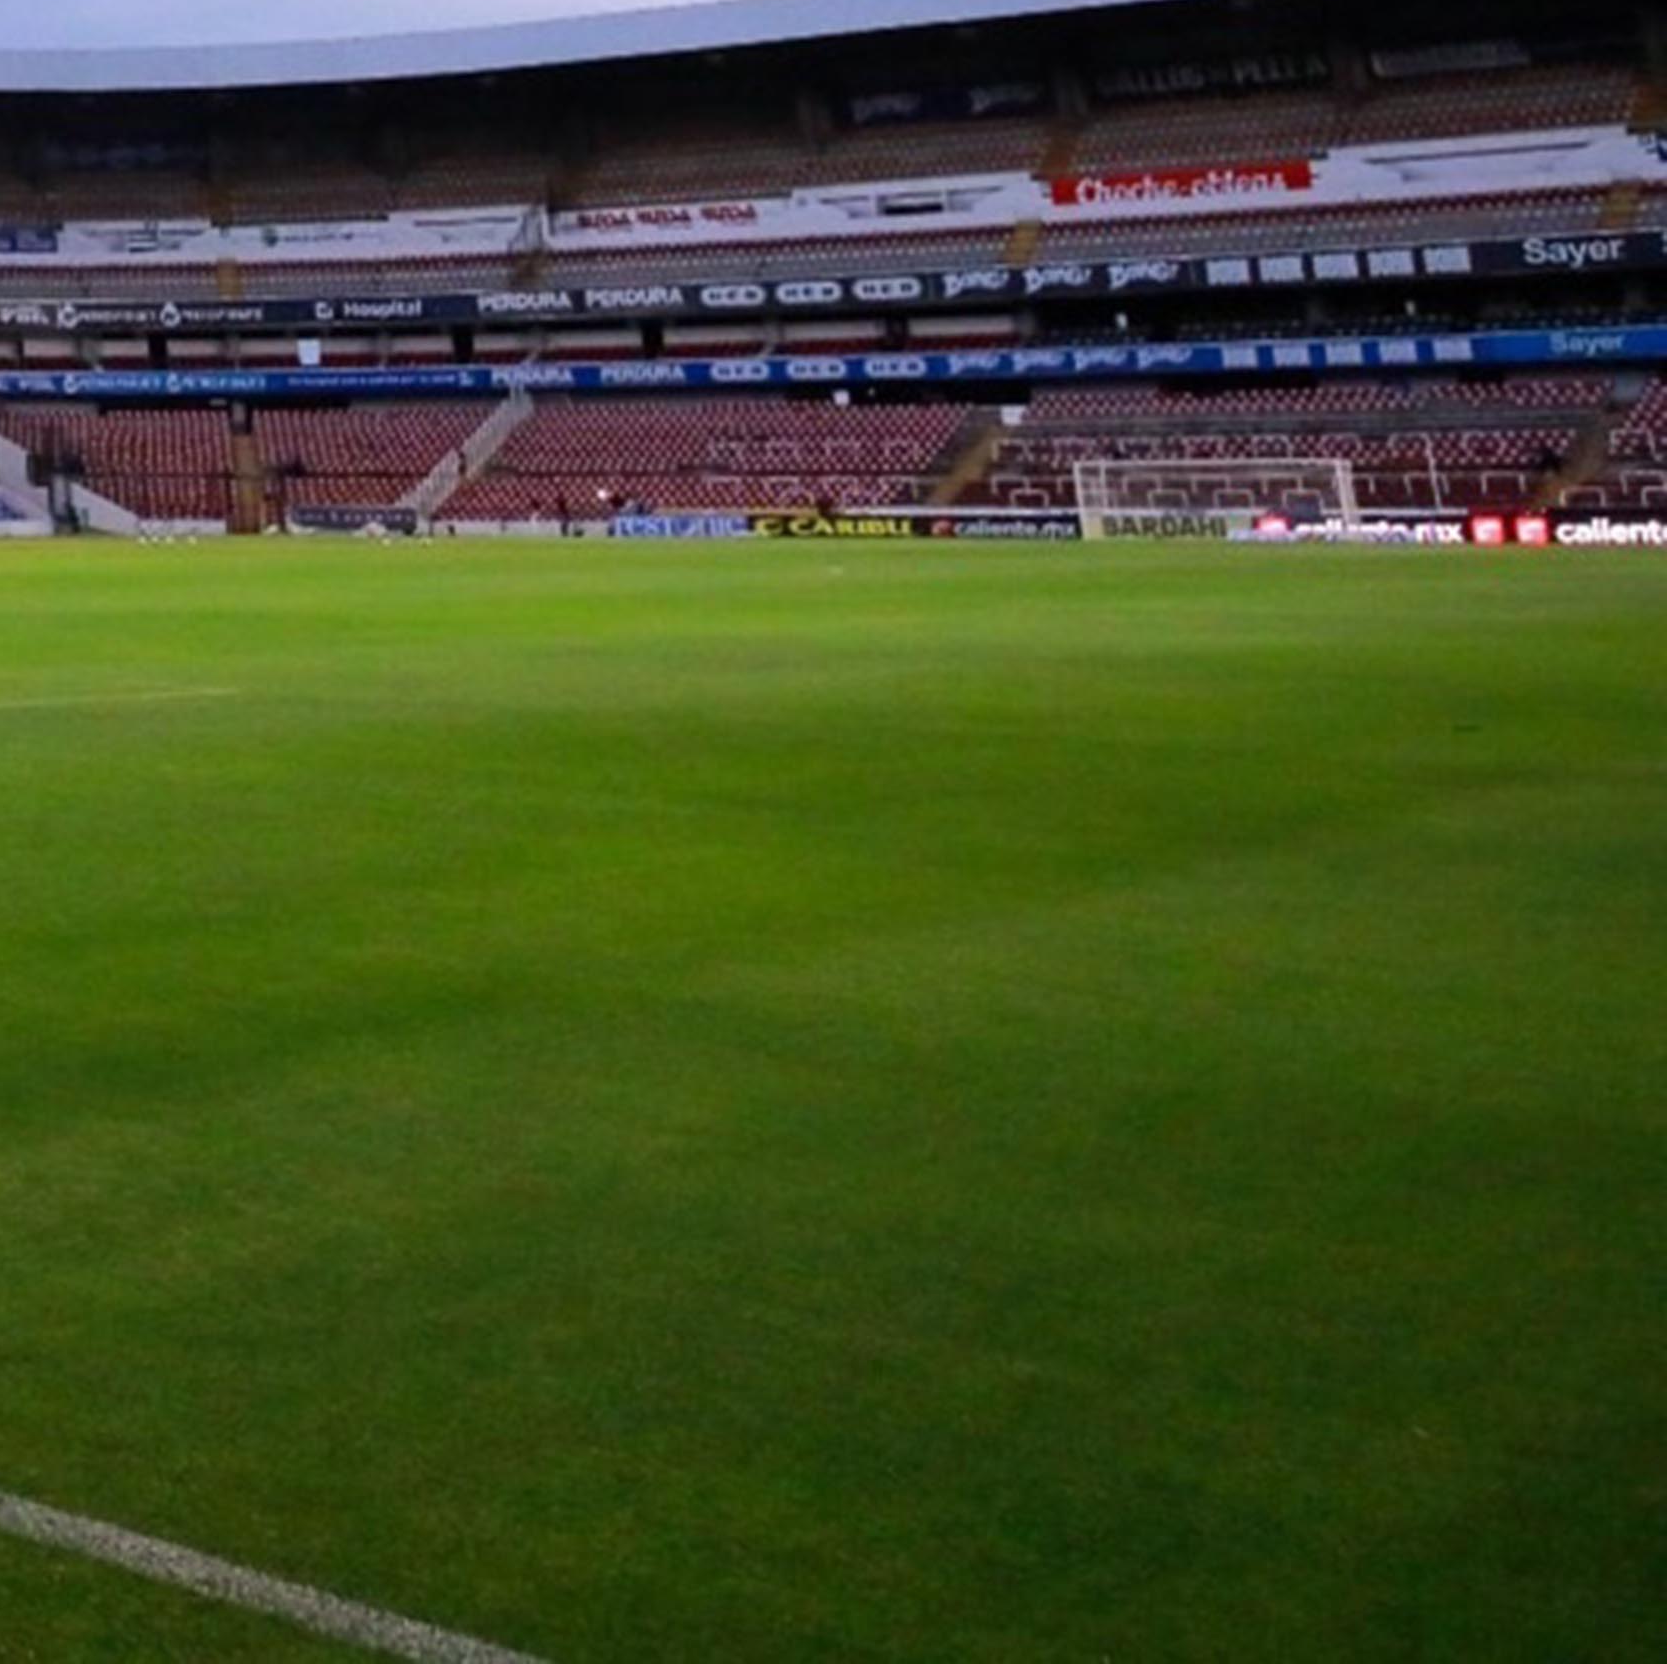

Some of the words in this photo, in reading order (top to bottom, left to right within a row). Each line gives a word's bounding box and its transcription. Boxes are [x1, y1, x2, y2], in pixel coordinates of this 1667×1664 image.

[1523, 237, 1627, 270] Sayer
[476, 289, 573, 314] PERDURA
[584, 284, 685, 312] PERDURA
[1550, 330, 1626, 357] Sayer
[1556, 516, 1667, 545] calient
